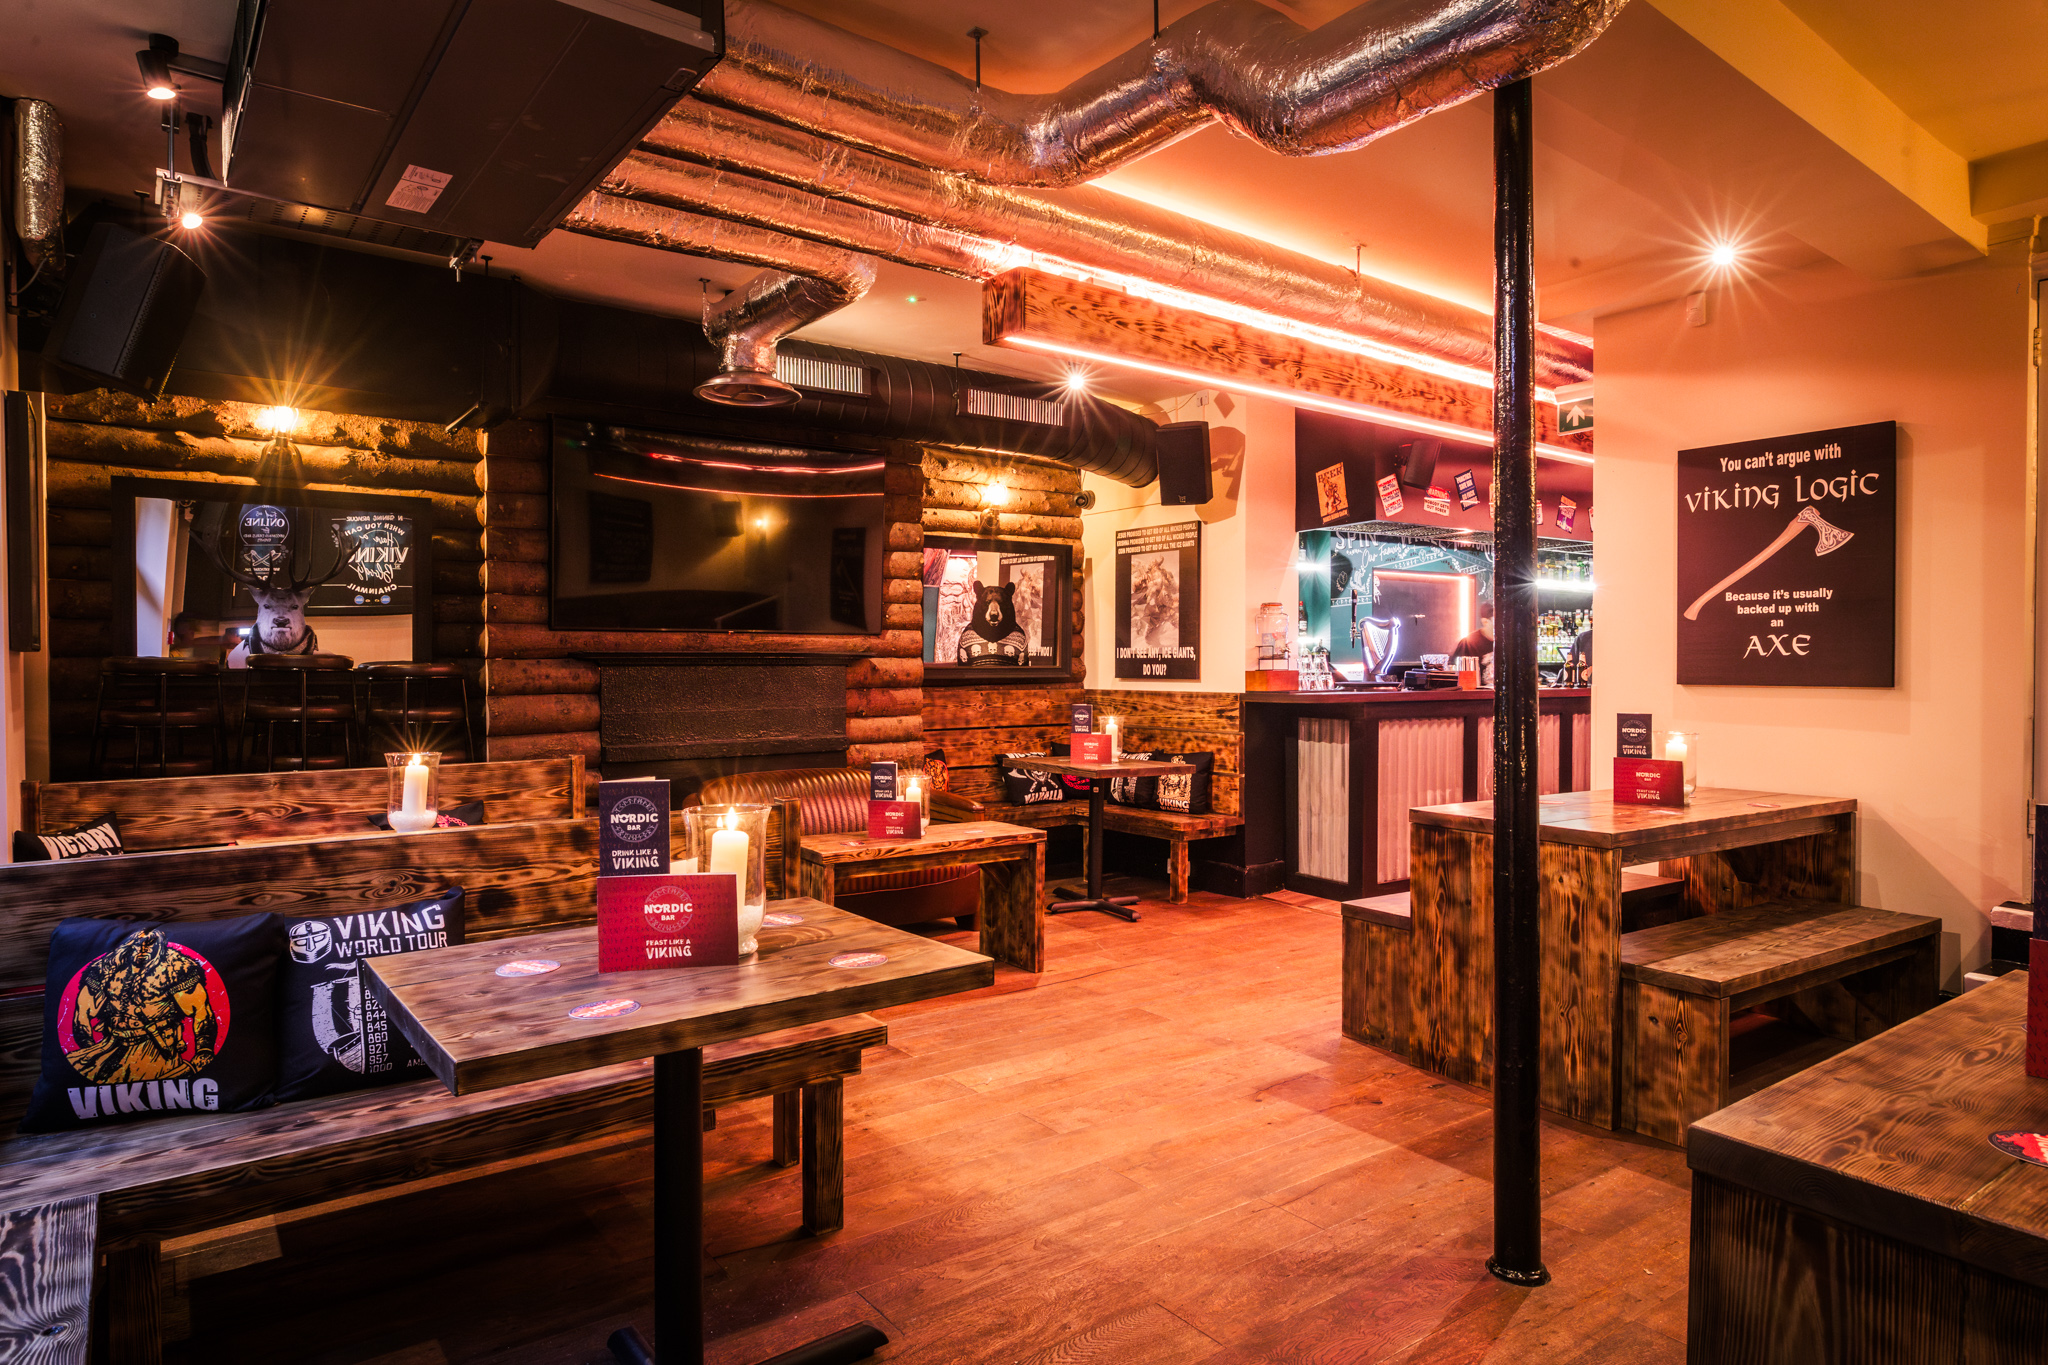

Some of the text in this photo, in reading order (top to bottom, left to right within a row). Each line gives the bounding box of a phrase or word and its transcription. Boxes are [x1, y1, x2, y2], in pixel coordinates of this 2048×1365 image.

[1720, 443, 1841, 472] You can't argue with
[1318, 466, 1342, 483] BEER
[1725, 588, 1833, 601] Because it's usually
[1737, 602, 1819, 615] backed up with
[1770, 619, 1784, 627] an
[1137, 648, 1147, 658] SEE
[1162, 647, 1172, 658] ICE
[1743, 634, 1811, 659] AXE
[1143, 664, 1167, 676] DO YOU?
[1024, 789, 1063, 804] VALHALLA
[1160, 798, 1189, 808] VIKING
[611, 813, 659, 823] NORDIC
[37, 823, 121, 860] VICTORY
[612, 856, 660, 870] VIKING
[644, 903, 693, 914] NORDIC
[333, 904, 445, 940] VIKING
[335, 931, 448, 958] WORLD TOUR
[646, 945, 692, 959] VIKING
[366, 1010, 386, 1022] 844
[367, 1021, 387, 1033] 845
[368, 1031, 388, 1044] 860
[369, 1043, 387, 1054] 921
[369, 1053, 389, 1065] 957
[67, 1078, 219, 1120] VIKING
